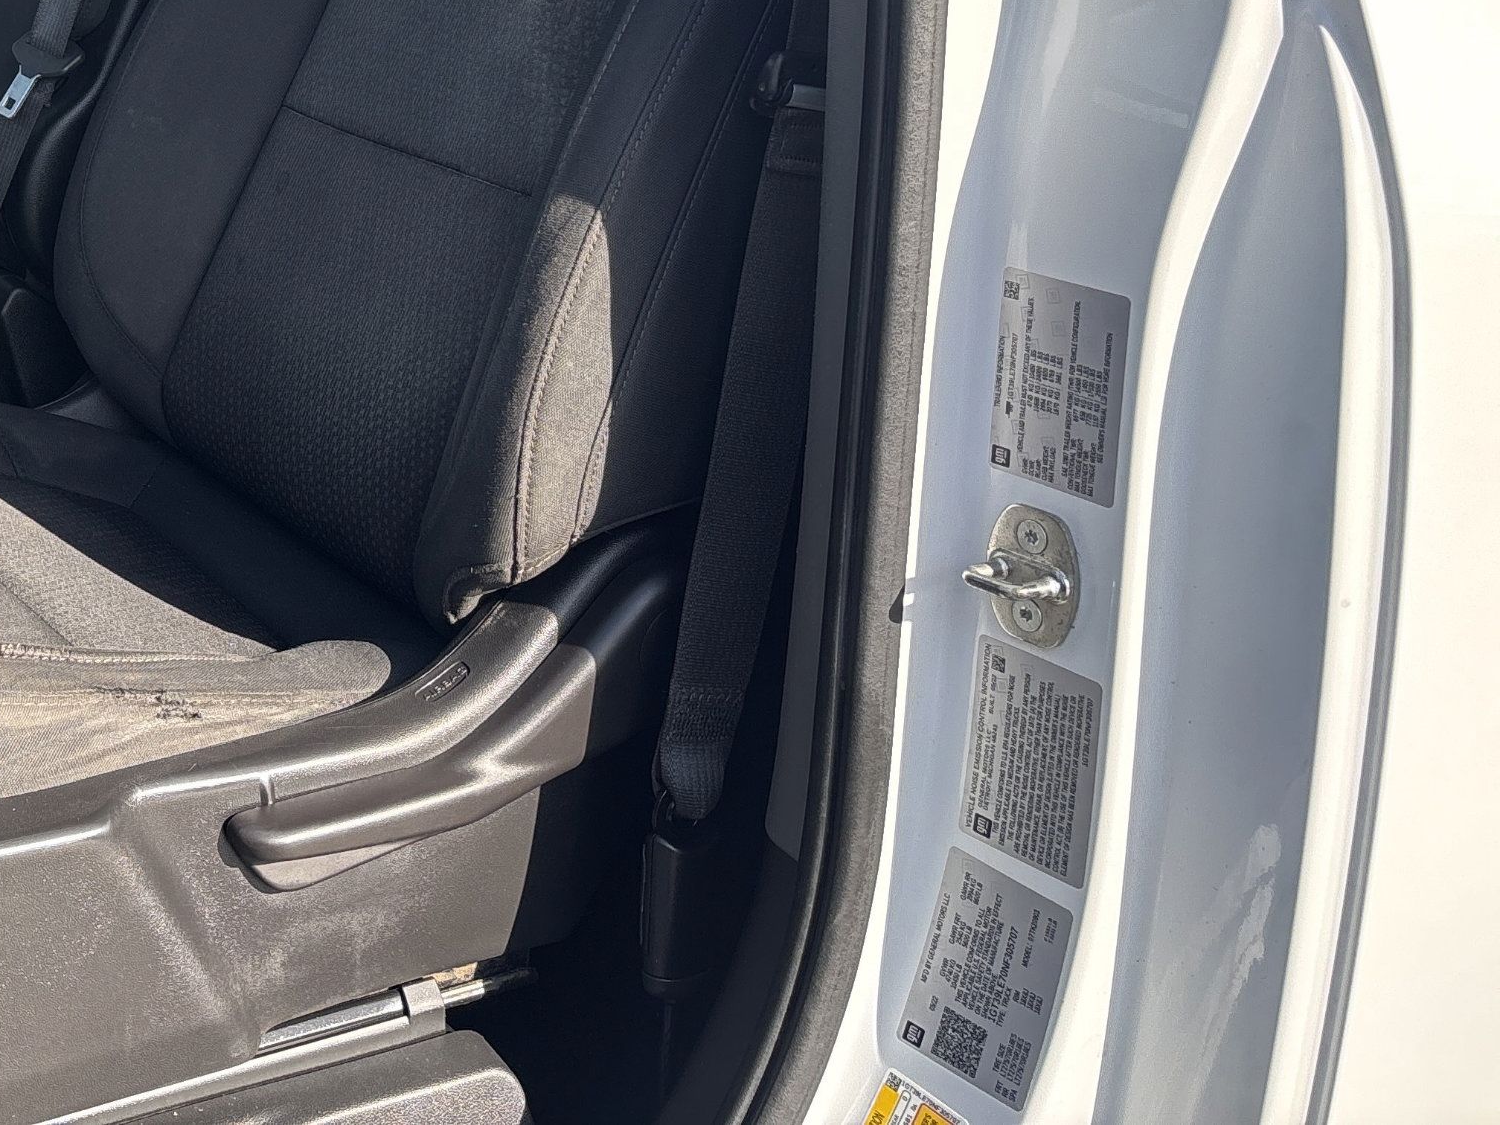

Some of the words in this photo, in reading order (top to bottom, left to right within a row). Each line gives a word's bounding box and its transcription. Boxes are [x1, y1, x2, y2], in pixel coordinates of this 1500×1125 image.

[997, 335, 1005, 374] INFORMATION
[981, 643, 992, 695] INFORMATION
[978, 697, 987, 733] CONTROL
[973, 732, 983, 770] EMISSION
[987, 744, 996, 779] MICHIGAN
[970, 771, 979, 795] NOISE
[978, 776, 986, 808] GENERAL
[982, 744, 990, 774] MOTORS
[997, 769, 1006, 799] CONFORMS
[966, 795, 976, 827] VEHICLE
[994, 799, 1002, 821] VEHICLE
[1002, 787, 1011, 820] APPLICABLE
[960, 881, 969, 900] GAWR
[920, 969, 929, 983] MFD
[928, 933, 941, 960] GENERAL
[936, 905, 947, 931] MOTORS
[942, 893, 950, 906] LLC
[949, 925, 958, 944] GAWR
[966, 929, 980, 963] CONFORMS
[987, 920, 1004, 967] MANUFACTURE
[961, 969, 977, 1008] APPLICABLE
[975, 930, 987, 957] FEDERAL
[982, 906, 992, 929] MOTOR
[968, 984, 980, 1010] VEHICLE
[975, 961, 986, 985] SAFETY
[981, 925, 995, 961] STANDARDS
[992, 893, 1002, 918] EFFECT
[1021, 943, 1033, 968] MODEL:
[940, 958, 949, 977] GVWR
[959, 962, 971, 988] VEHICLE
[986, 926, 1018, 1023] 1GT39LE70NF305707
[955, 989, 964, 1003] THIS
[977, 991, 986, 1004] THE
[981, 975, 990, 992] DATE
[1001, 986, 1012, 1008] TRUCK
[1012, 990, 1020, 1003] RIM
[981, 996, 992, 1019] SHOWN
[905, 1022, 922, 1046] gm
[992, 1057, 1002, 1072] TIRE
